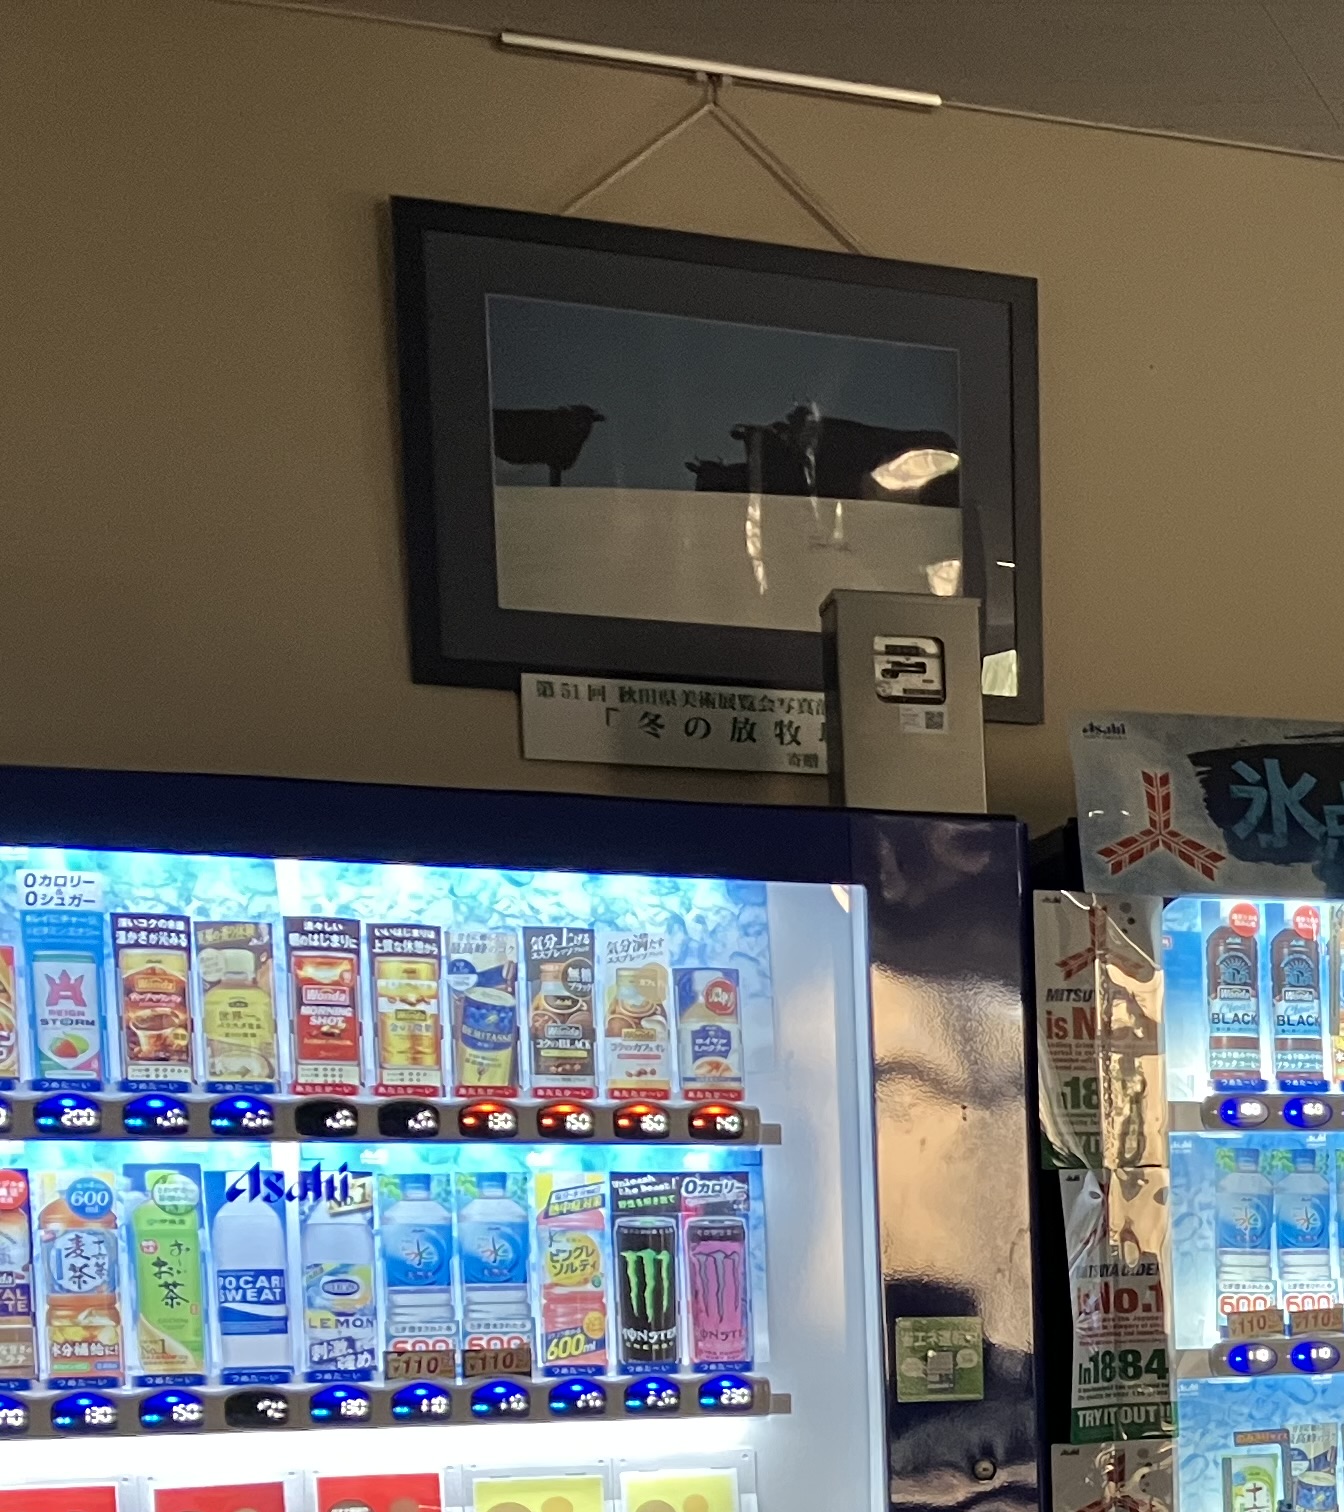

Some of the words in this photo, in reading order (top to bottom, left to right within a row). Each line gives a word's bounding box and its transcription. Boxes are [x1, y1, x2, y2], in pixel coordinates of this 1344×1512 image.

[23, 872, 96, 889] 0カロリー
[24, 890, 96, 908] 0シュガー
[529, 927, 591, 949] 気分上げる
[306, 988, 347, 1002] Wonda
[1220, 989, 1249, 999] Wonda
[1285, 990, 1313, 1000] Wonda
[300, 1006, 354, 1017] MORNING
[1211, 1012, 1258, 1026] BLACK
[40, 1018, 96, 1027] STORM
[309, 1015, 345, 1028] SHOT
[1276, 1014, 1320, 1027] BLACK
[61, 1108, 96, 1126] 200
[225, 1161, 351, 1204] Asahi
[681, 1178, 748, 1196] 0カロリー
[70, 1190, 109, 1206] 600
[64, 1233, 97, 1290] 麦茶
[218, 1287, 283, 1302] SWEAT
[307, 1316, 374, 1329] LEMON
[1089, 1348, 1169, 1384] 1884
[1077, 1410, 1102, 1428] TRY
[1103, 1408, 1118, 1426] IT
